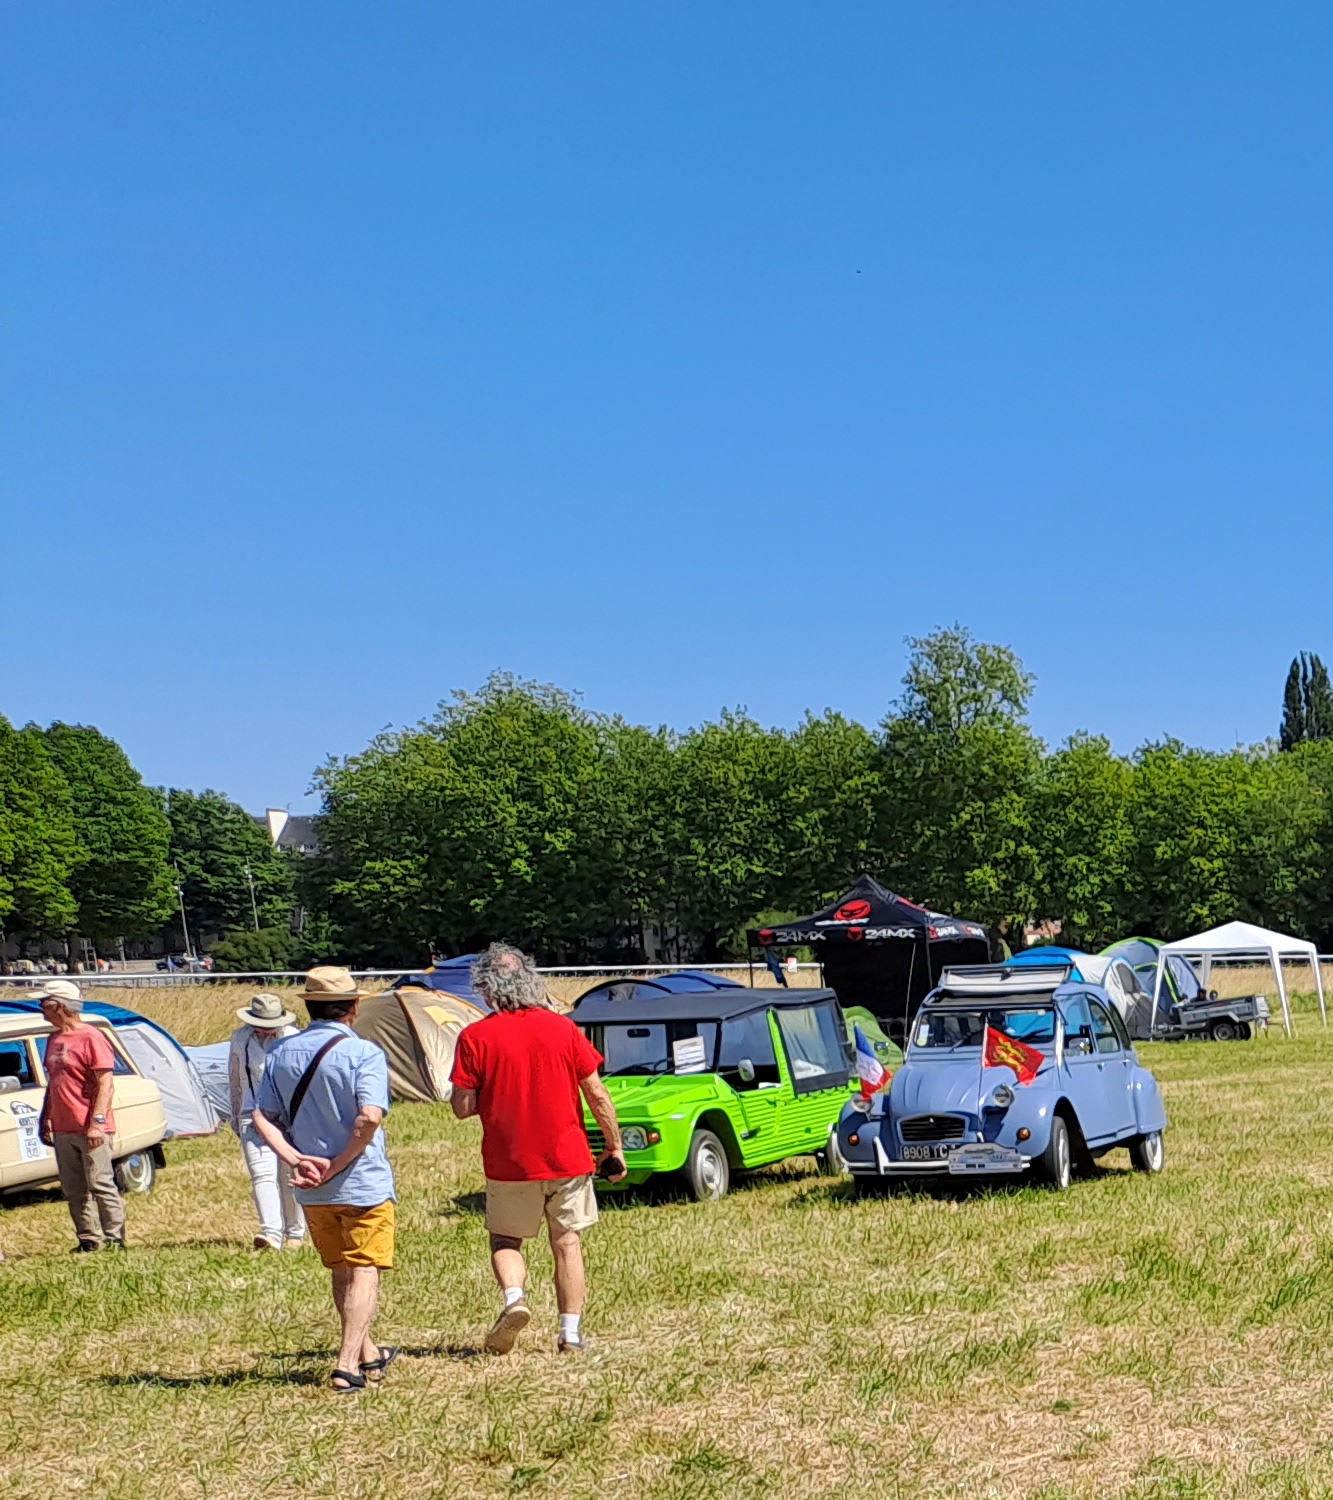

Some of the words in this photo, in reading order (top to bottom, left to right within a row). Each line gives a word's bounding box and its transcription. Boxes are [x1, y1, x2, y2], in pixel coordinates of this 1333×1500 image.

[775, 930, 827, 942] 24MX
[864, 928, 916, 939] 24MX
[903, 1145, 930, 1160] 8908
